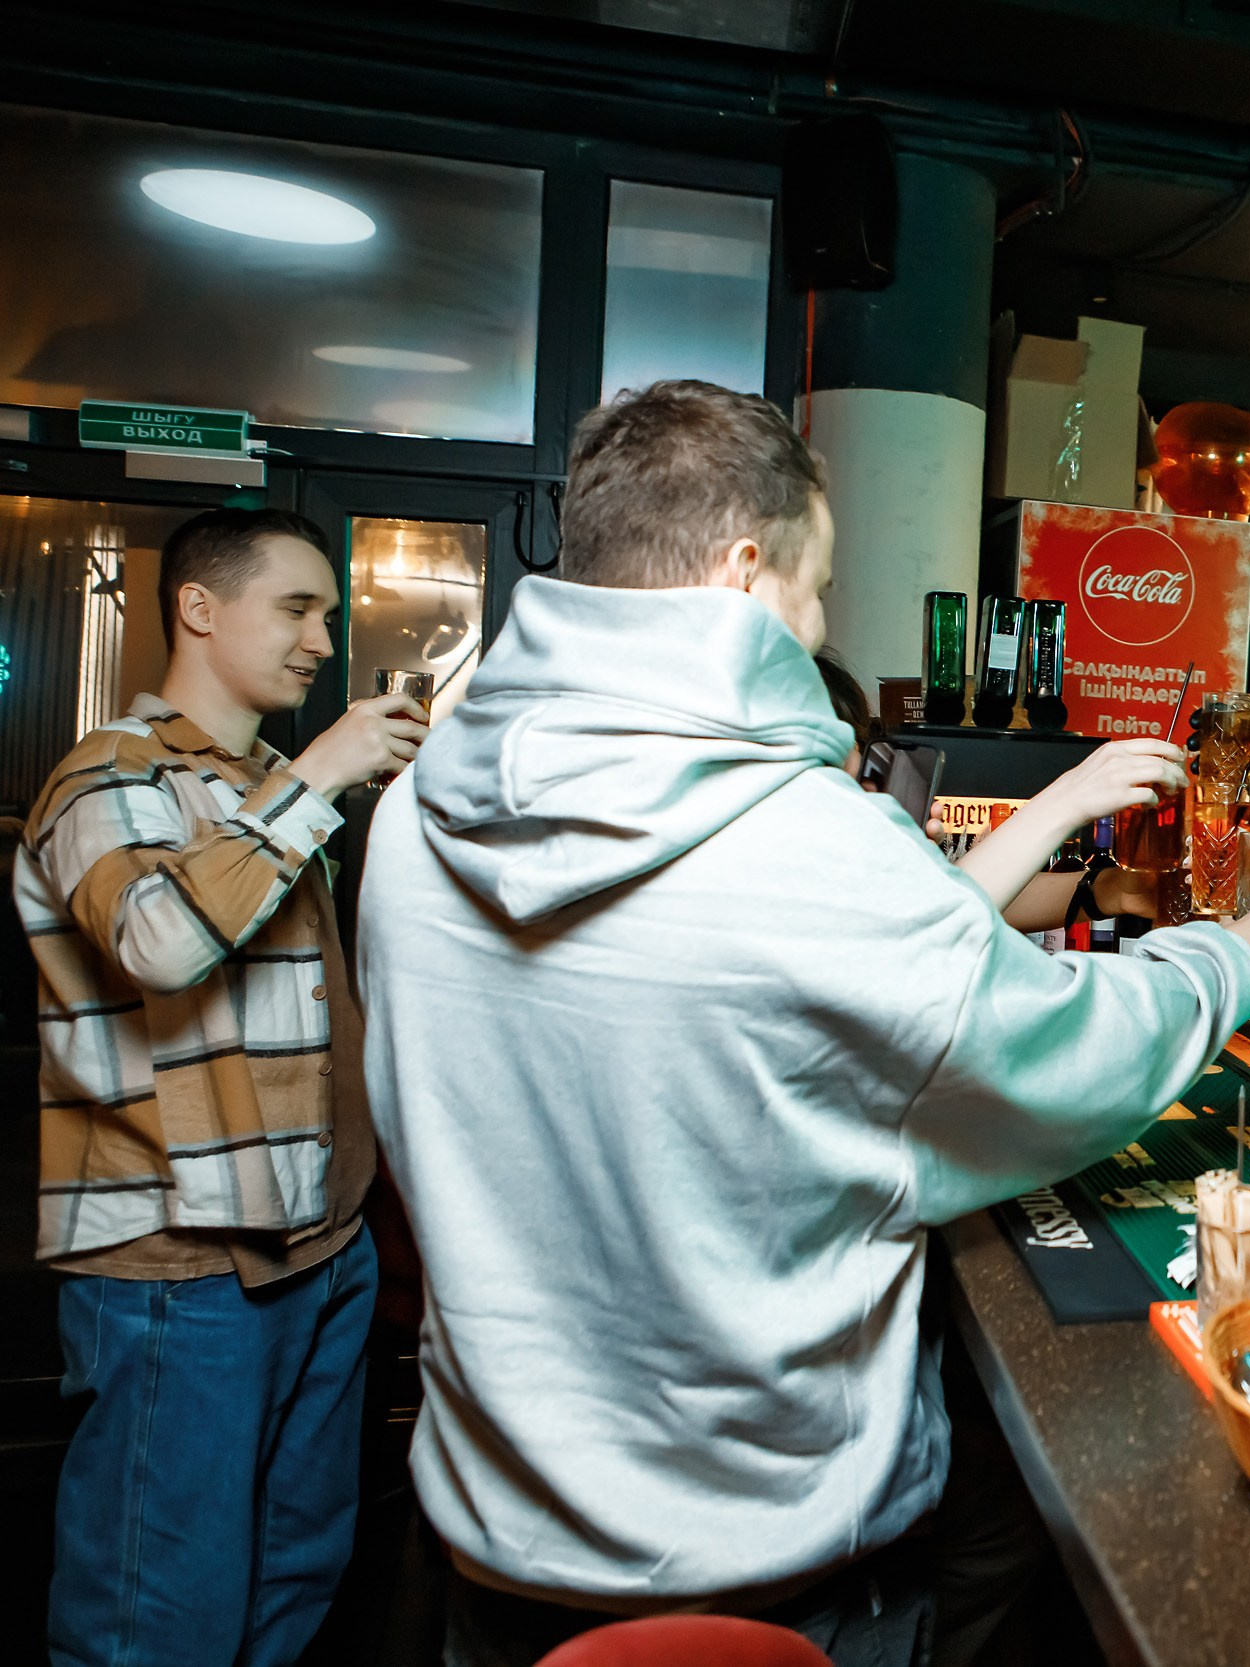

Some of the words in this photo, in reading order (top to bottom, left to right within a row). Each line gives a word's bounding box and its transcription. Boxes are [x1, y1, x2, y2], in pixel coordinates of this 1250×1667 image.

[122, 425, 203, 444] ВЫХОД
[1063, 656, 1207, 685] Салқындатып
[1080, 678, 1181, 706] Ішіңіздер
[1096, 714, 1162, 736] Пейте
